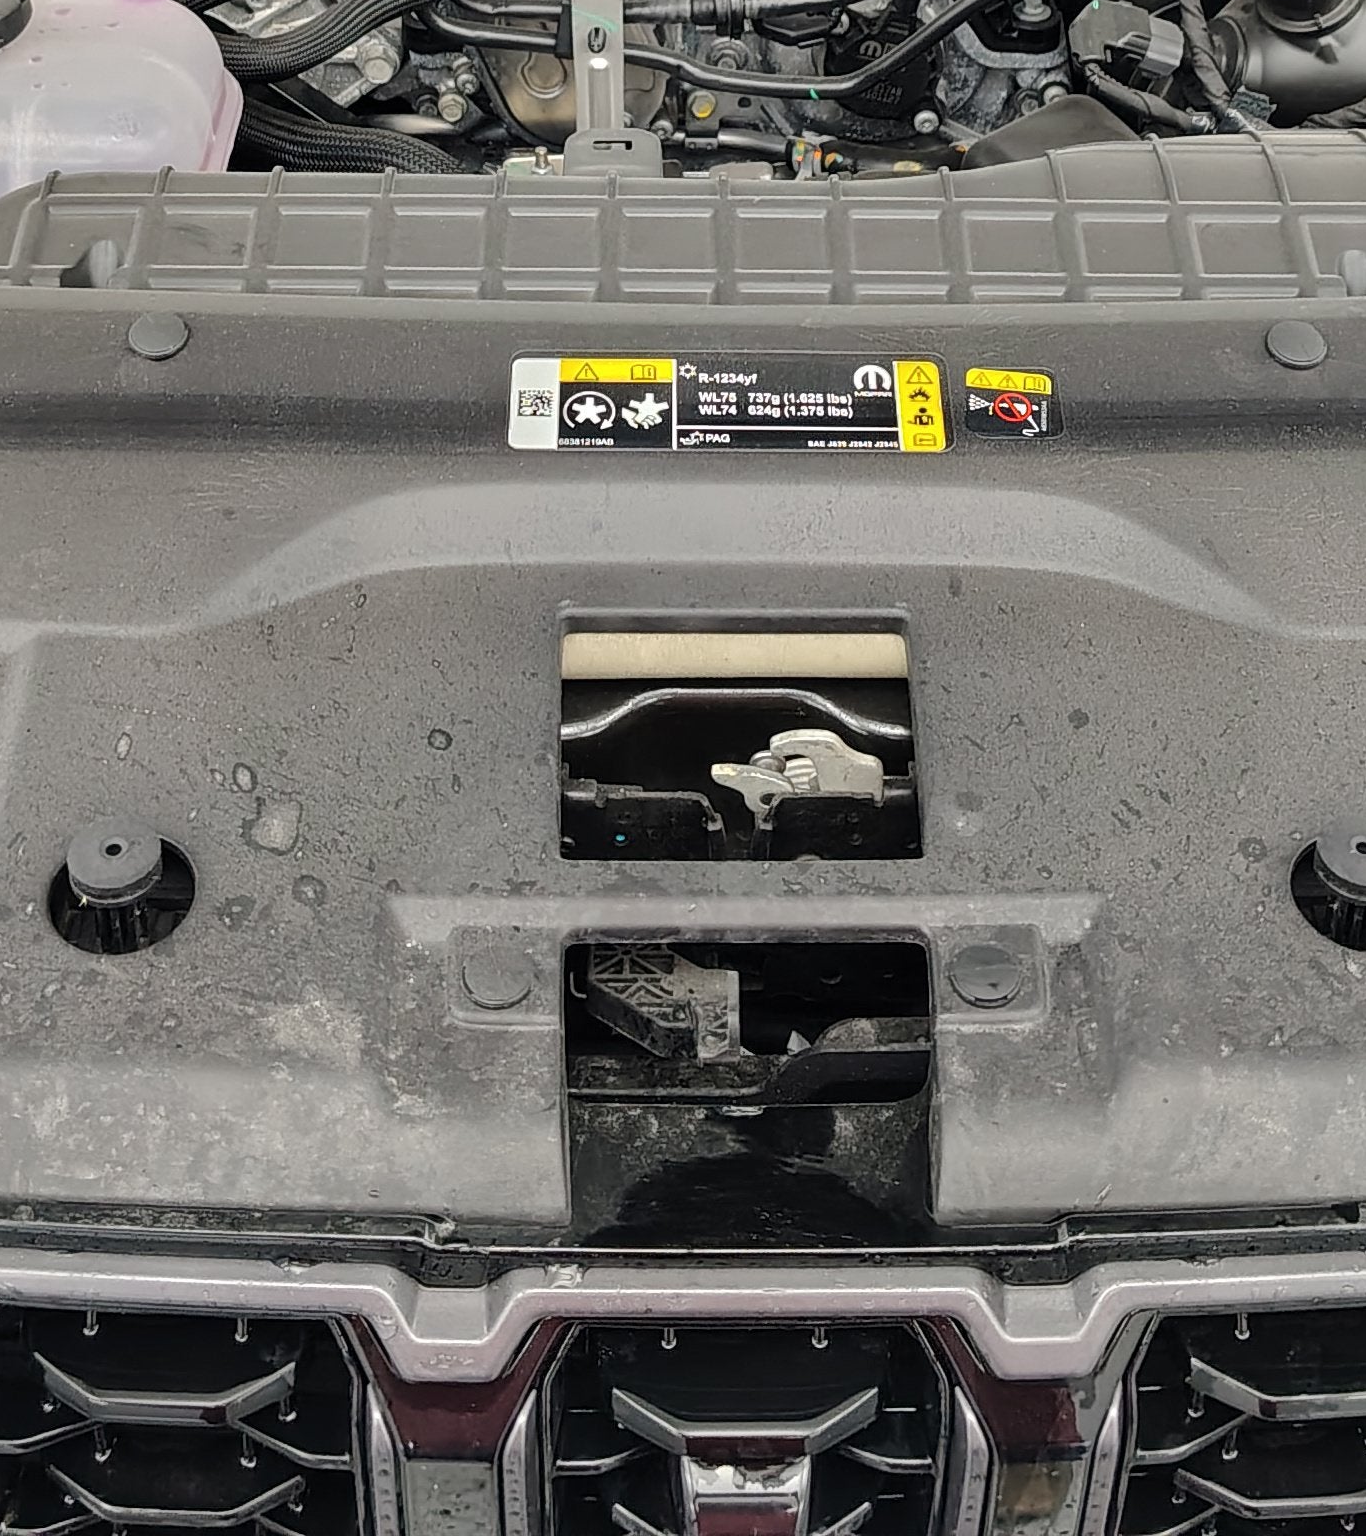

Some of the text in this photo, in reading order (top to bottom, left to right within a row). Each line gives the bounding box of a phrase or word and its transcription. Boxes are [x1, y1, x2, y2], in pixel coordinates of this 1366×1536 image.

[698, 372, 757, 386] R-1234yf
[698, 392, 853, 405] WL75 737g (1.625 lbs)
[698, 404, 854, 418] WL74 624g (1.375 lbs)
[705, 434, 731, 444] PAG
